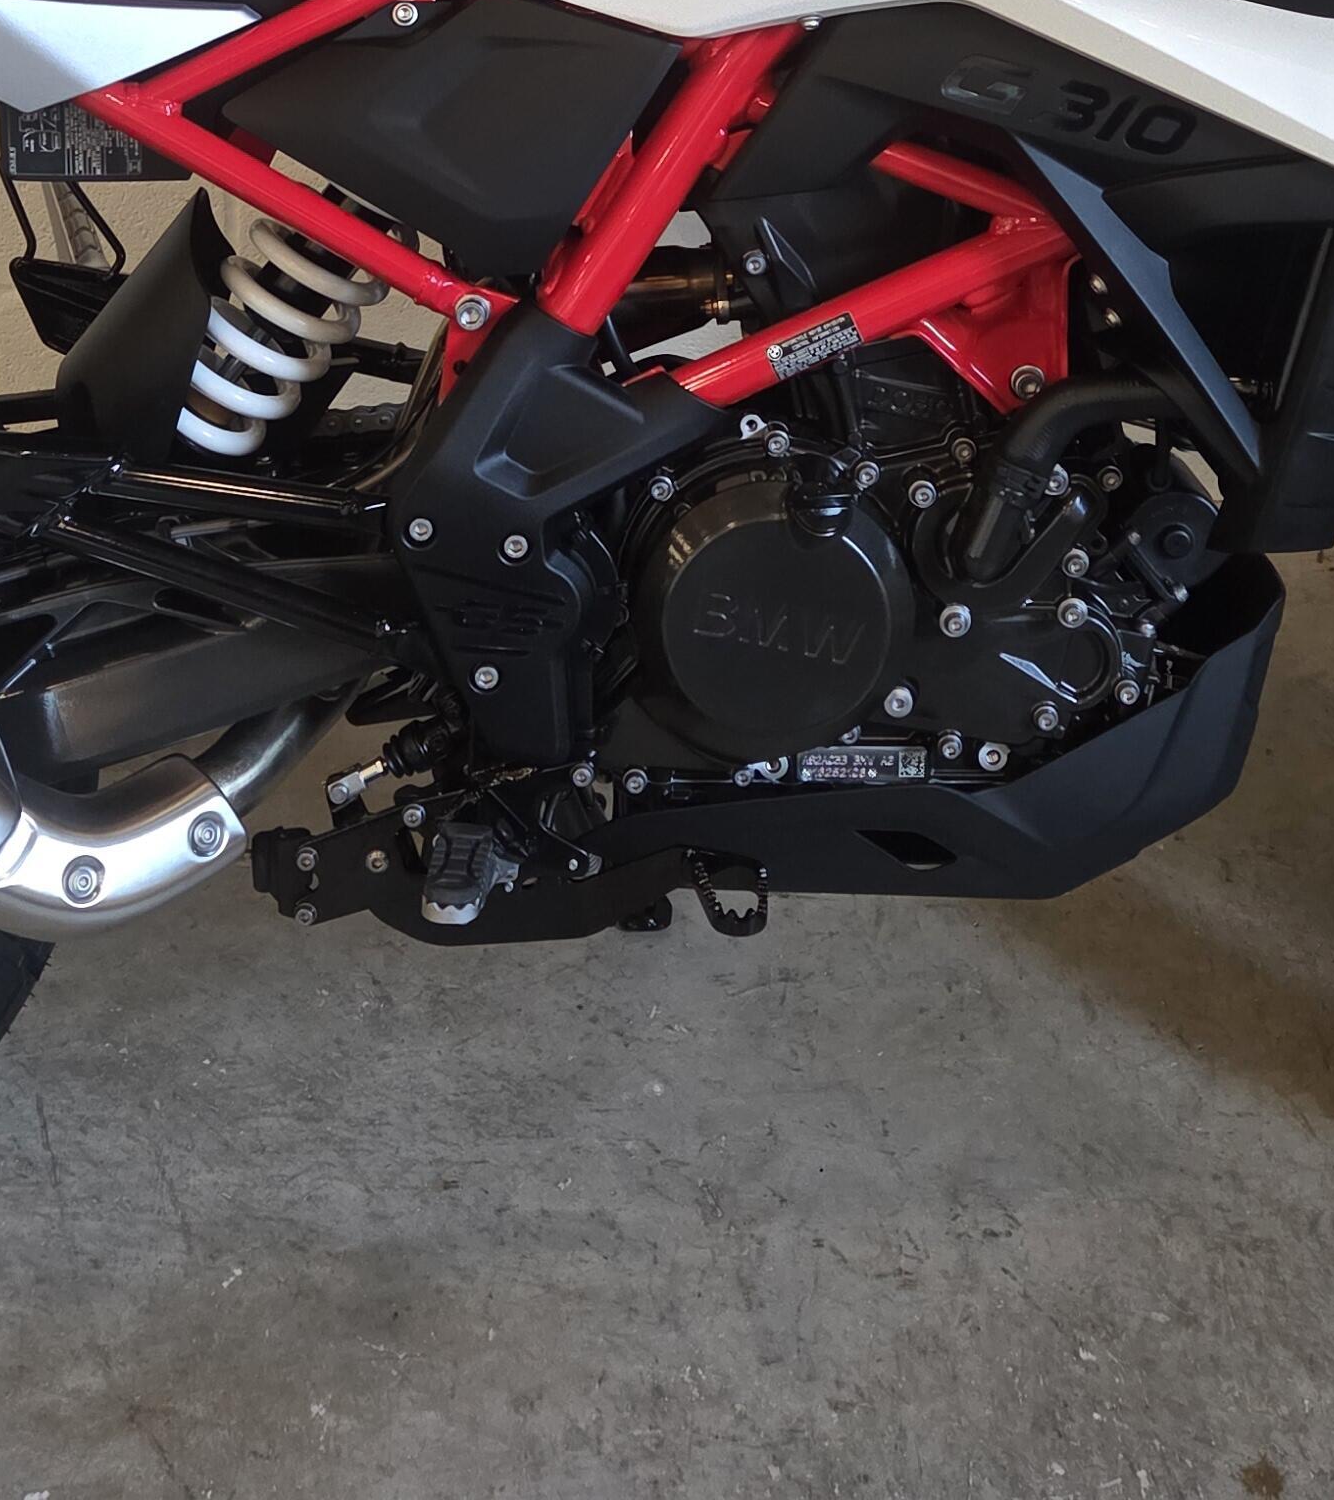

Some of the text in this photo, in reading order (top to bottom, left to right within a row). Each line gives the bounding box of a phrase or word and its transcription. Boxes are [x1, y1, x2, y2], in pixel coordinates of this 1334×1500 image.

[940, 53, 1198, 155] G 310
[693, 591, 868, 665] BMW
